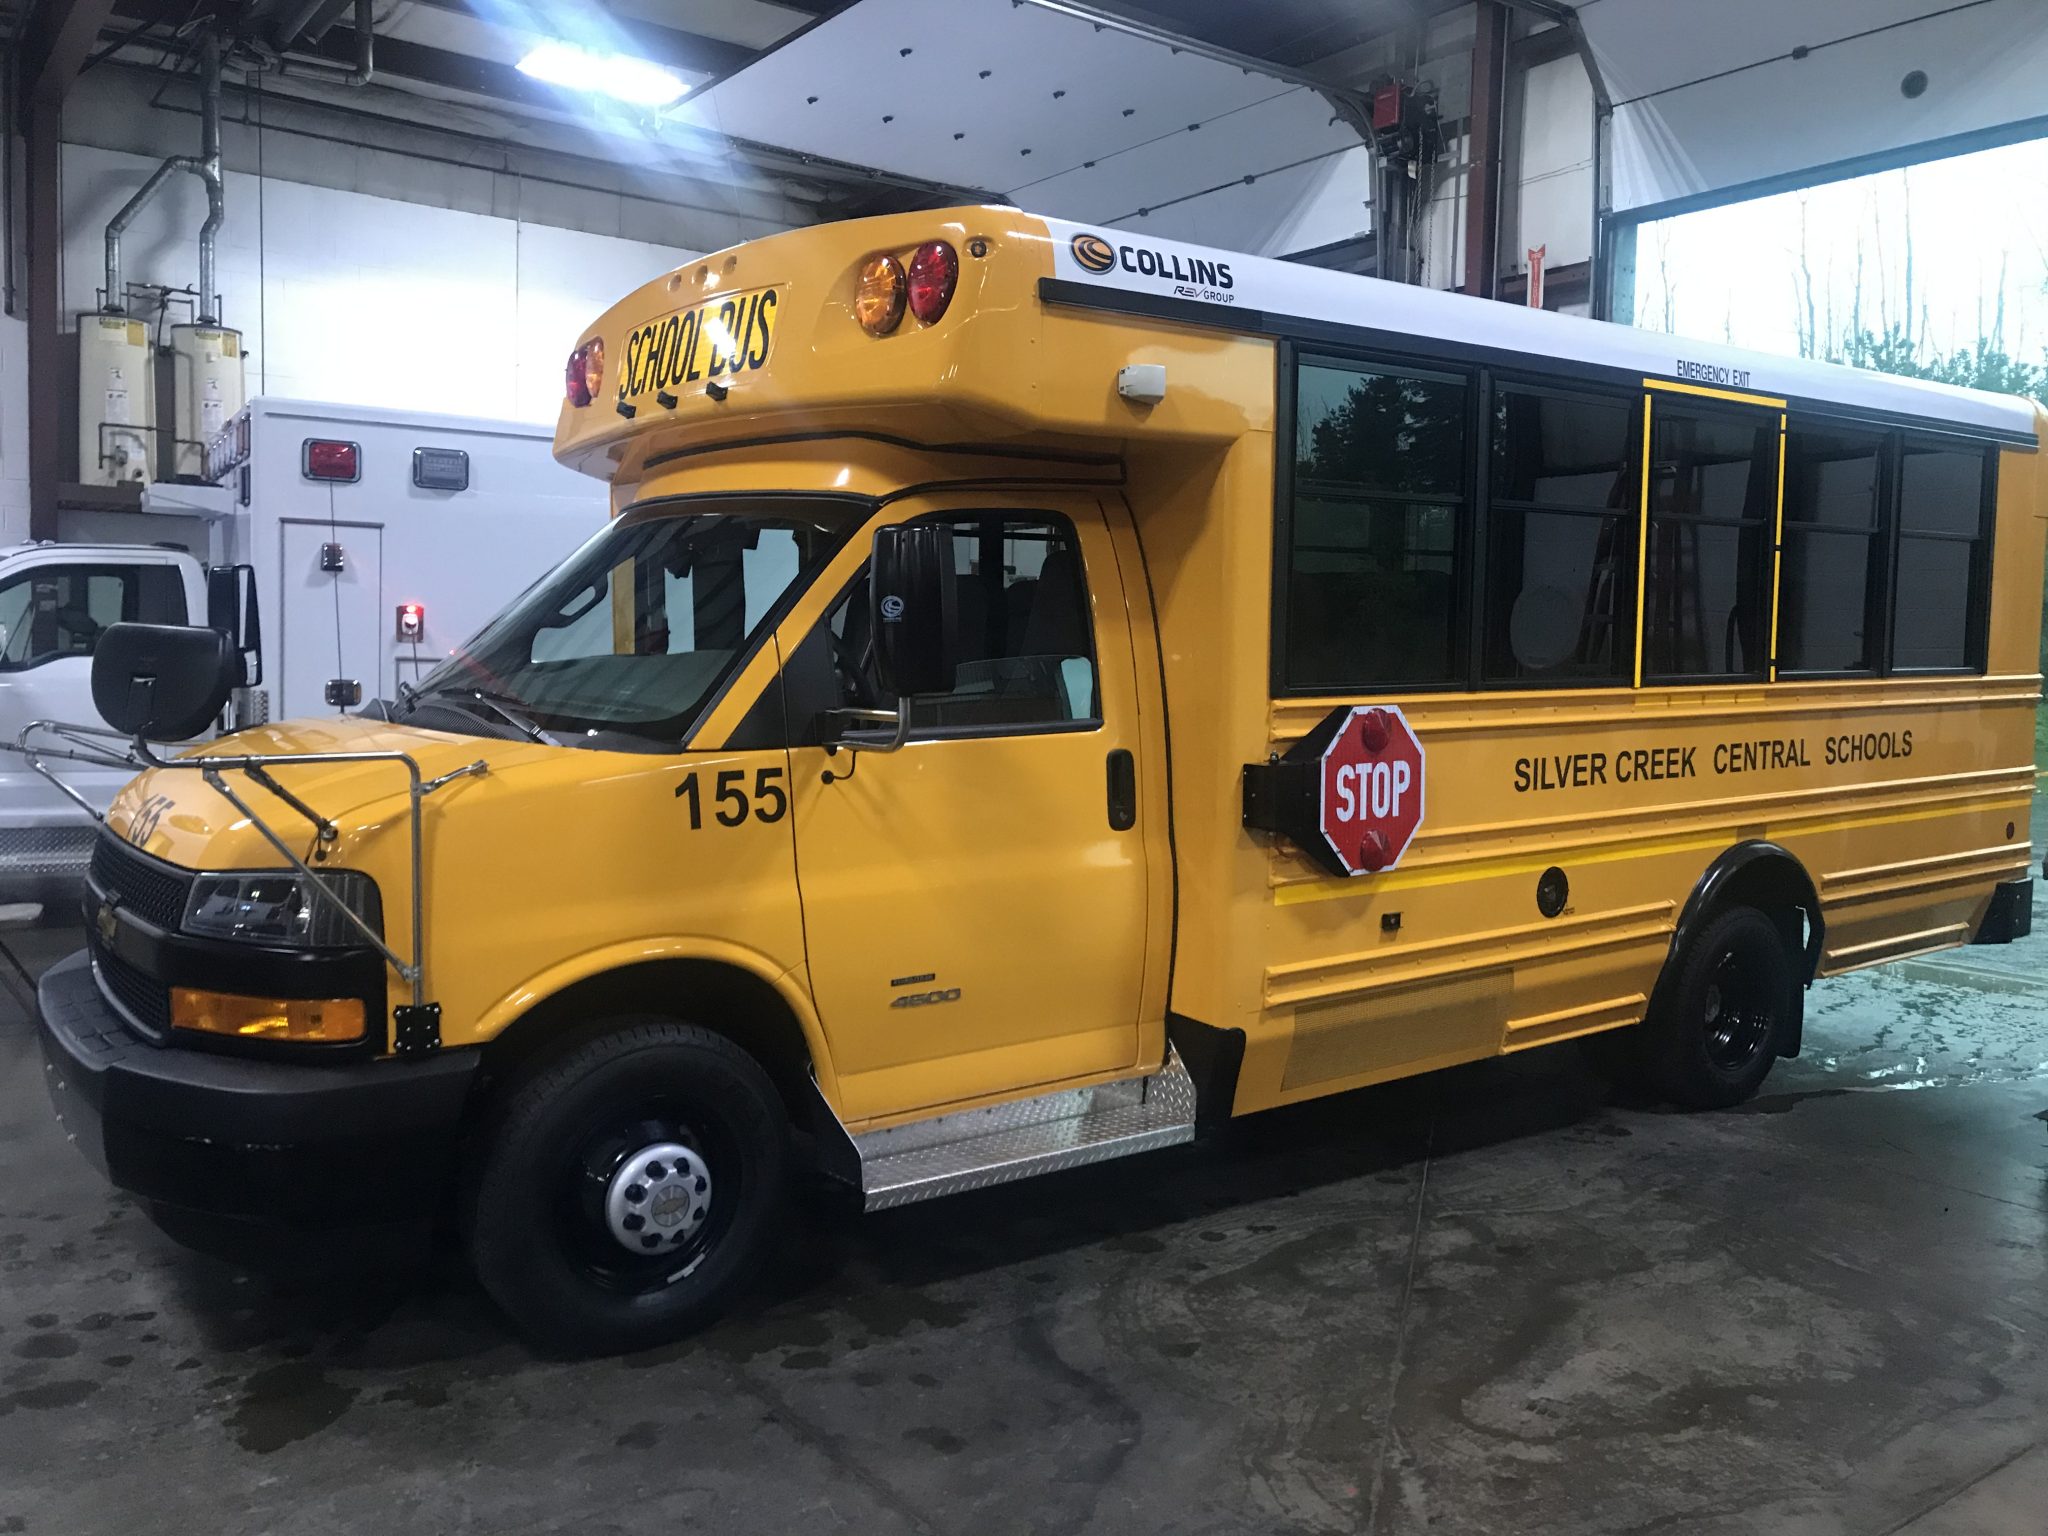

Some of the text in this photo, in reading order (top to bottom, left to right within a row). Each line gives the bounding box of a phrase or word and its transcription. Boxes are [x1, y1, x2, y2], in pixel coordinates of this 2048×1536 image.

[1119, 245, 1234, 289] COLLINS
[1173, 285, 1235, 304] REV GROUP
[618, 288, 777, 401] SCHOOL BUS
[1677, 359, 1751, 387] EMERGENCY EXIT
[1513, 729, 1913, 793] SILVER CREEK CENTRAL SCHOOLS
[674, 767, 788, 830] 155
[1335, 760, 1411, 822] STOP
[125, 793, 176, 848] 155
